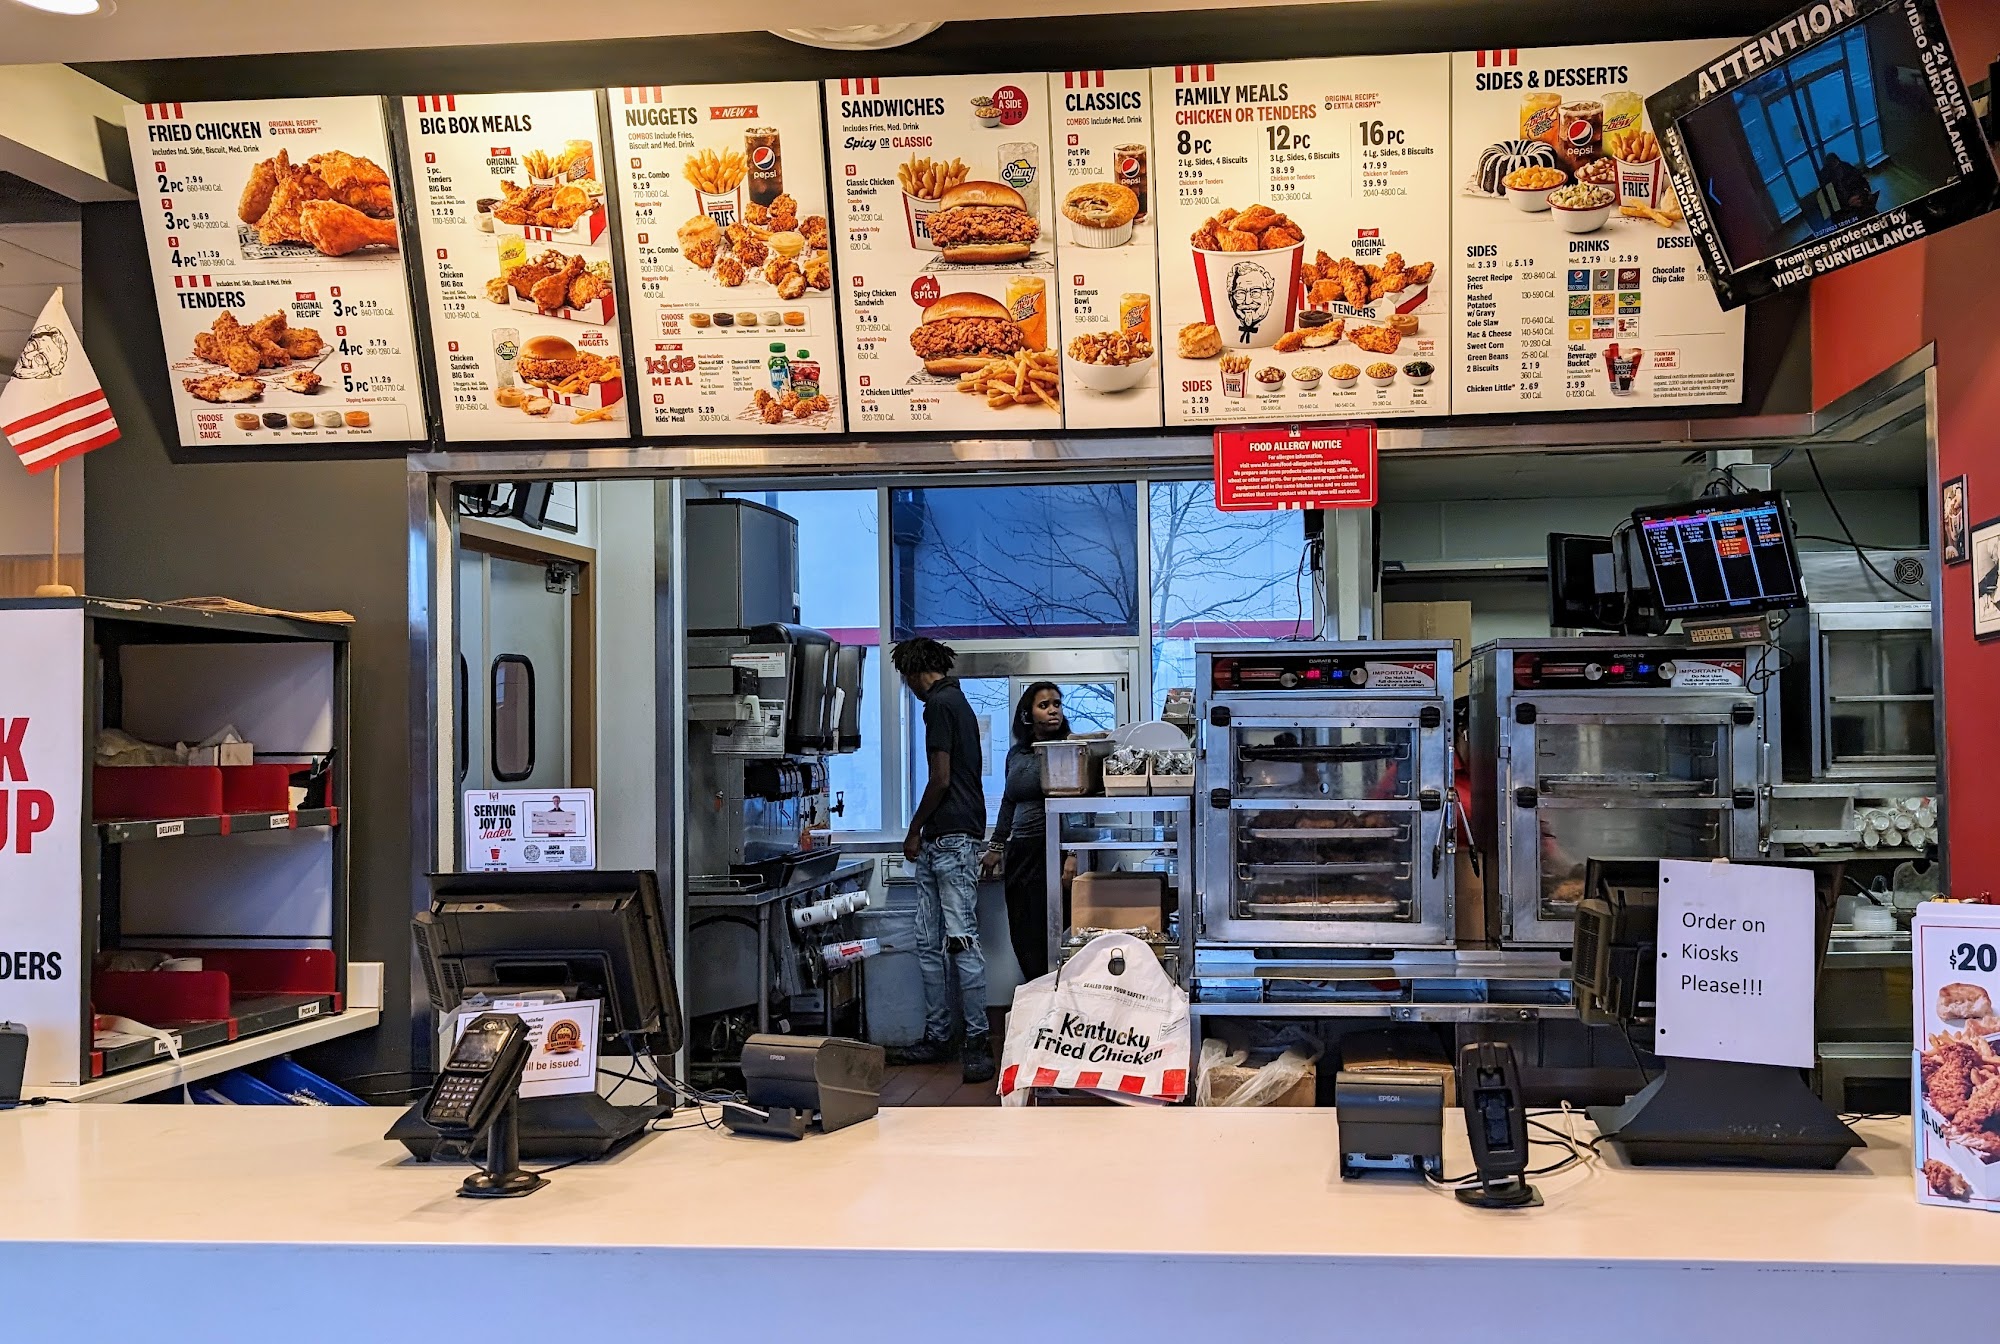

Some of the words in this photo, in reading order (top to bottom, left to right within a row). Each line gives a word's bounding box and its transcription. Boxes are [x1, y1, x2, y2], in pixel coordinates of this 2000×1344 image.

[1699, 0, 1856, 100] ATTENTION
[1476, 71, 1523, 91] SIDES
[1528, 71, 1539, 87] &
[1544, 66, 1628, 87] DESSERTS
[1932, 42, 1948, 65] 24
[1941, 67, 1966, 119] HOUR
[999, 91, 1014, 99] ADD
[1066, 92, 1141, 111] CLASSICS
[1175, 86, 1231, 106] FAMILY
[1235, 83, 1288, 102] MEALS
[842, 98, 945, 118] SANDWICHES
[999, 100, 1004, 108] A
[1006, 99, 1022, 108] SIDE
[626, 107, 698, 126] NUGGETS
[722, 108, 746, 117] NEW
[1175, 108, 1232, 125] CHICKEN
[1236, 107, 1254, 122] OR
[1257, 104, 1316, 120] TENDERS
[1922, 52, 1974, 174] SURVEILLANCE
[149, 124, 192, 142] FRIED
[196, 121, 262, 140] CHICKEN
[420, 118, 446, 134] BIG
[448, 117, 480, 133] BOX
[483, 115, 532, 132] MEALS
[1177, 130, 1191, 154] 8
[1194, 140, 1211, 154] PC
[1267, 125, 1290, 150] 12
[1293, 135, 1310, 149] PC
[1359, 121, 1384, 146] 16
[1387, 130, 1404, 144] PC
[844, 136, 876, 149] Spicy
[880, 138, 889, 146] OR
[893, 137, 932, 147] CLASSIC
[1567, 146, 1593, 156] pepsi
[1314, 152, 1340, 160] Biscuits
[754, 170, 776, 179] pepsi
[1002, 163, 1036, 181] Starry
[158, 175, 169, 192] 2
[170, 181, 184, 192] PC
[1623, 181, 1649, 197] FRIES
[1673, 174, 1694, 216] HOUR
[165, 213, 174, 230] 3
[177, 219, 190, 229] PC
[1690, 219, 1702, 237] 24
[1569, 240, 1609, 253] DRINKS
[1775, 243, 1827, 269] Premises
[1829, 219, 1887, 251] protected
[1889, 208, 1907, 226] by
[171, 250, 182, 267] 4
[184, 257, 196, 267] PC
[1467, 245, 1497, 257] SIDES
[1705, 233, 1726, 274] VIDEO
[1772, 265, 1813, 288] VIDEO
[1815, 220, 1926, 272] SURVEILLANCE
[1490, 273, 1512, 282] Recipe
[1652, 266, 1685, 274] Chocolate
[1652, 275, 1666, 284] Chip
[1667, 274, 1684, 282] Cake
[177, 291, 245, 308] TENDERS
[854, 290, 871, 298] Spicy
[914, 291, 938, 299] SPICY
[334, 300, 343, 316] 3
[345, 306, 357, 316] PC
[1332, 302, 1375, 318] TENDERS
[1467, 319, 1481, 327] Cole
[1467, 330, 1480, 338] Mac
[1489, 329, 1512, 338] Cheese
[339, 339, 349, 355] 4
[351, 345, 363, 355] PC
[645, 355, 696, 374] kids
[344, 376, 353, 393] 5
[356, 382, 368, 391] PC
[652, 377, 693, 386] MEAL
[1182, 380, 1212, 392] SIDES
[1250, 442, 1271, 451] FOOD
[1274, 441, 1310, 450] ALLERGY
[1312, 440, 1342, 449] NOTICE
[474, 805, 516, 816] SERVING
[159, 824, 182, 834] DELIVERY
[272, 817, 289, 825] DELIVER
[479, 818, 497, 829] JOY
[499, 818, 511, 829] TO
[1682, 912, 1736, 930] Order
[1743, 920, 1765, 932] on
[1682, 944, 1738, 962] Kiosks
[1950, 943, 1997, 972] $20
[1682, 975, 1762, 996] Please!!!
[1127, 991, 1145, 1000] SAFETY
[301, 1005, 317, 1016] PICK-UP
[1060, 1012, 1150, 1051] Kentucky
[1033, 1028, 1085, 1060] Fried
[1089, 1044, 1163, 1065] Chicken
[525, 1062, 533, 1071] ill
[537, 1062, 546, 1070] be
